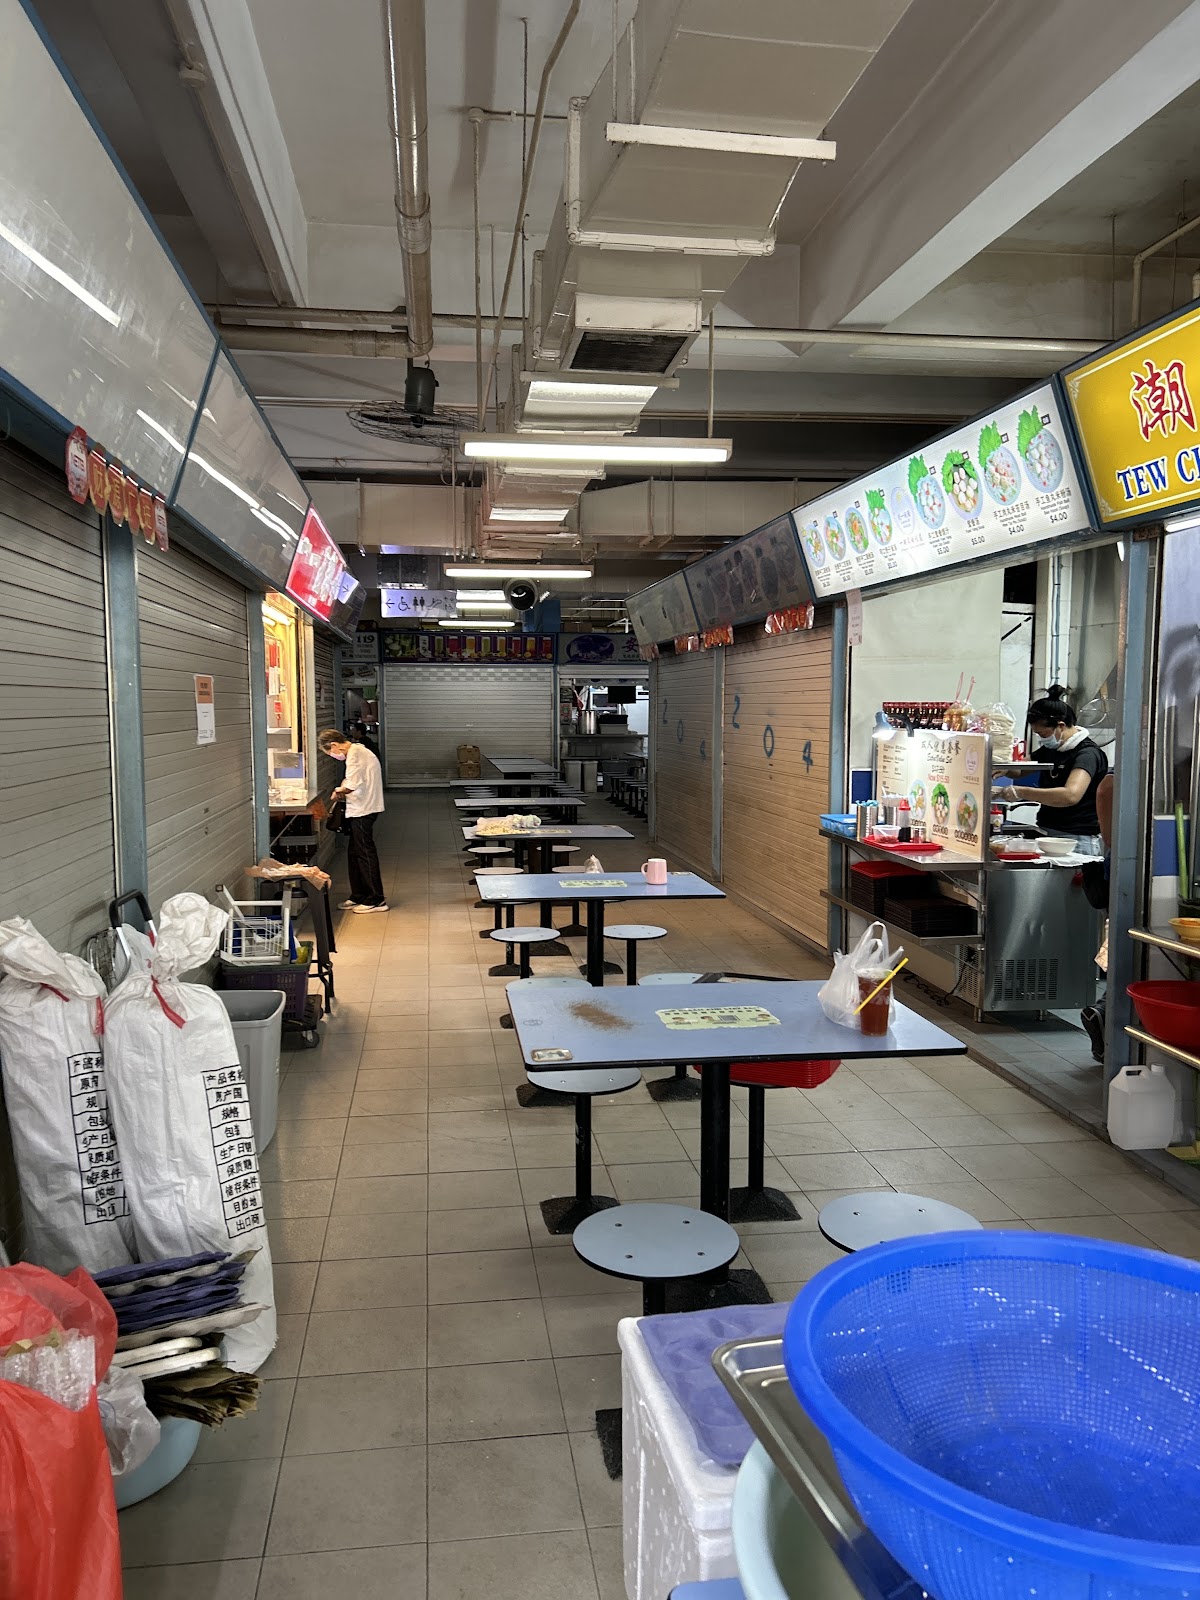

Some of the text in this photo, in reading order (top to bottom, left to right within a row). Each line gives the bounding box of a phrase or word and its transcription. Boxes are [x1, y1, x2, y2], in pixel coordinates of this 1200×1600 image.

[1131, 360, 1197, 441] 潮
[1117, 446, 1200, 499] TEW C
[1050, 511, 1068, 524] $4.00
[1008, 524, 1025, 535] $4.00
[356, 634, 375, 644] 119
[221, 1106, 240, 1120] 规格
[226, 1159, 253, 1178] 保质期
[225, 1175, 259, 1198] 储存条件
[233, 1195, 258, 1213] 目的地
[236, 1213, 261, 1232] 出口商
